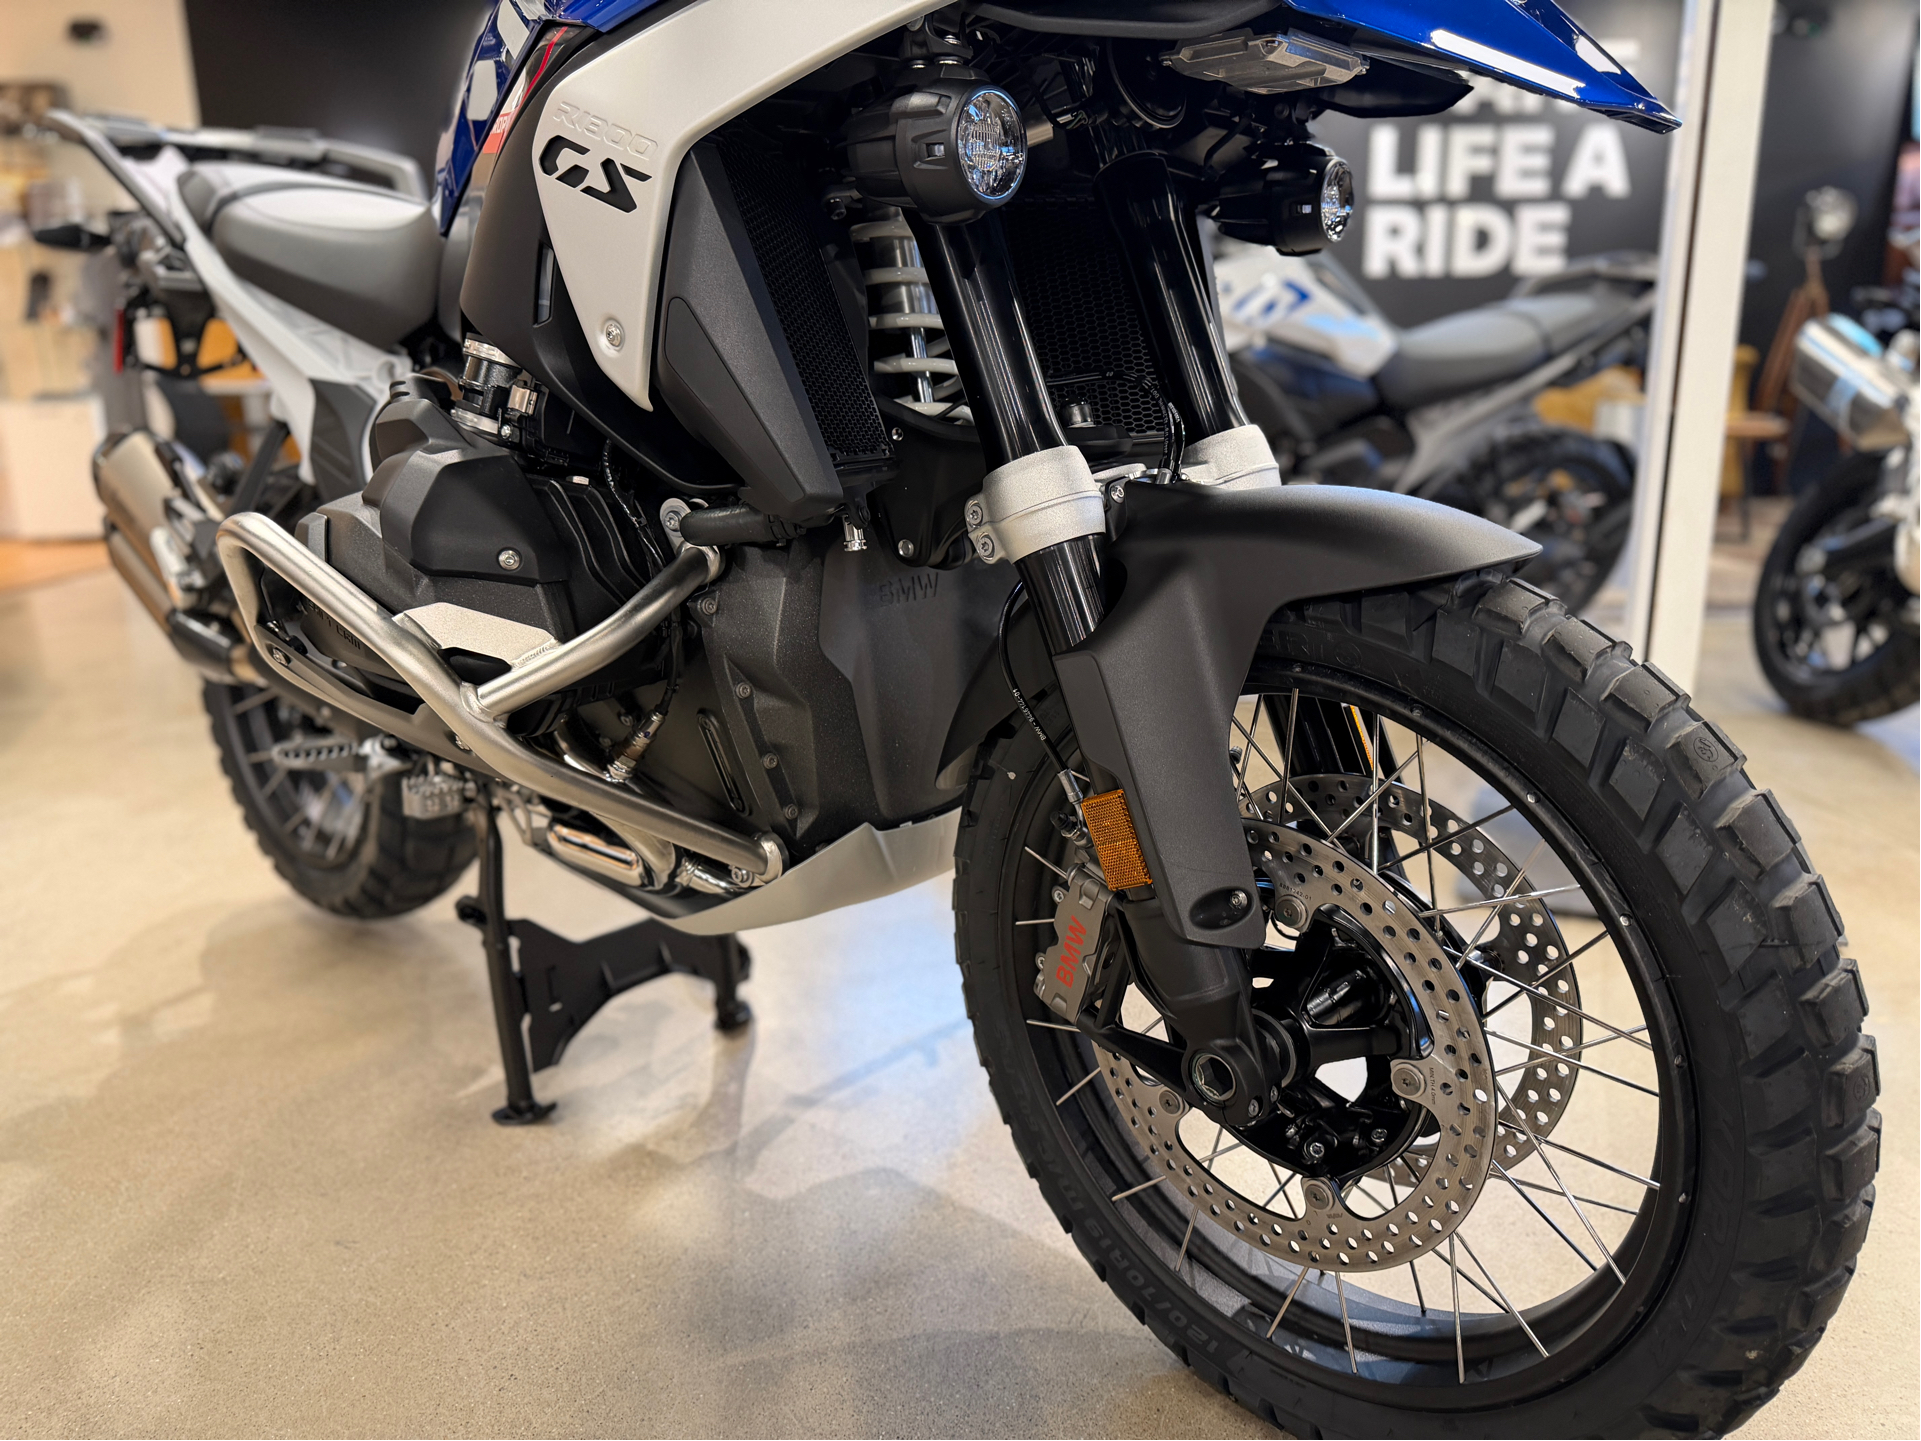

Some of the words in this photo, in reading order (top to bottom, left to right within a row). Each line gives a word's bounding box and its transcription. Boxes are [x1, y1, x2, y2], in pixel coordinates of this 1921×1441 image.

[539, 134, 653, 213] GS
[1368, 122, 1556, 200] LIFE
[1560, 122, 1632, 200] A
[1361, 202, 1571, 280] RIDE
[879, 571, 939, 608] BMW
[1055, 915, 1087, 989] BMW
